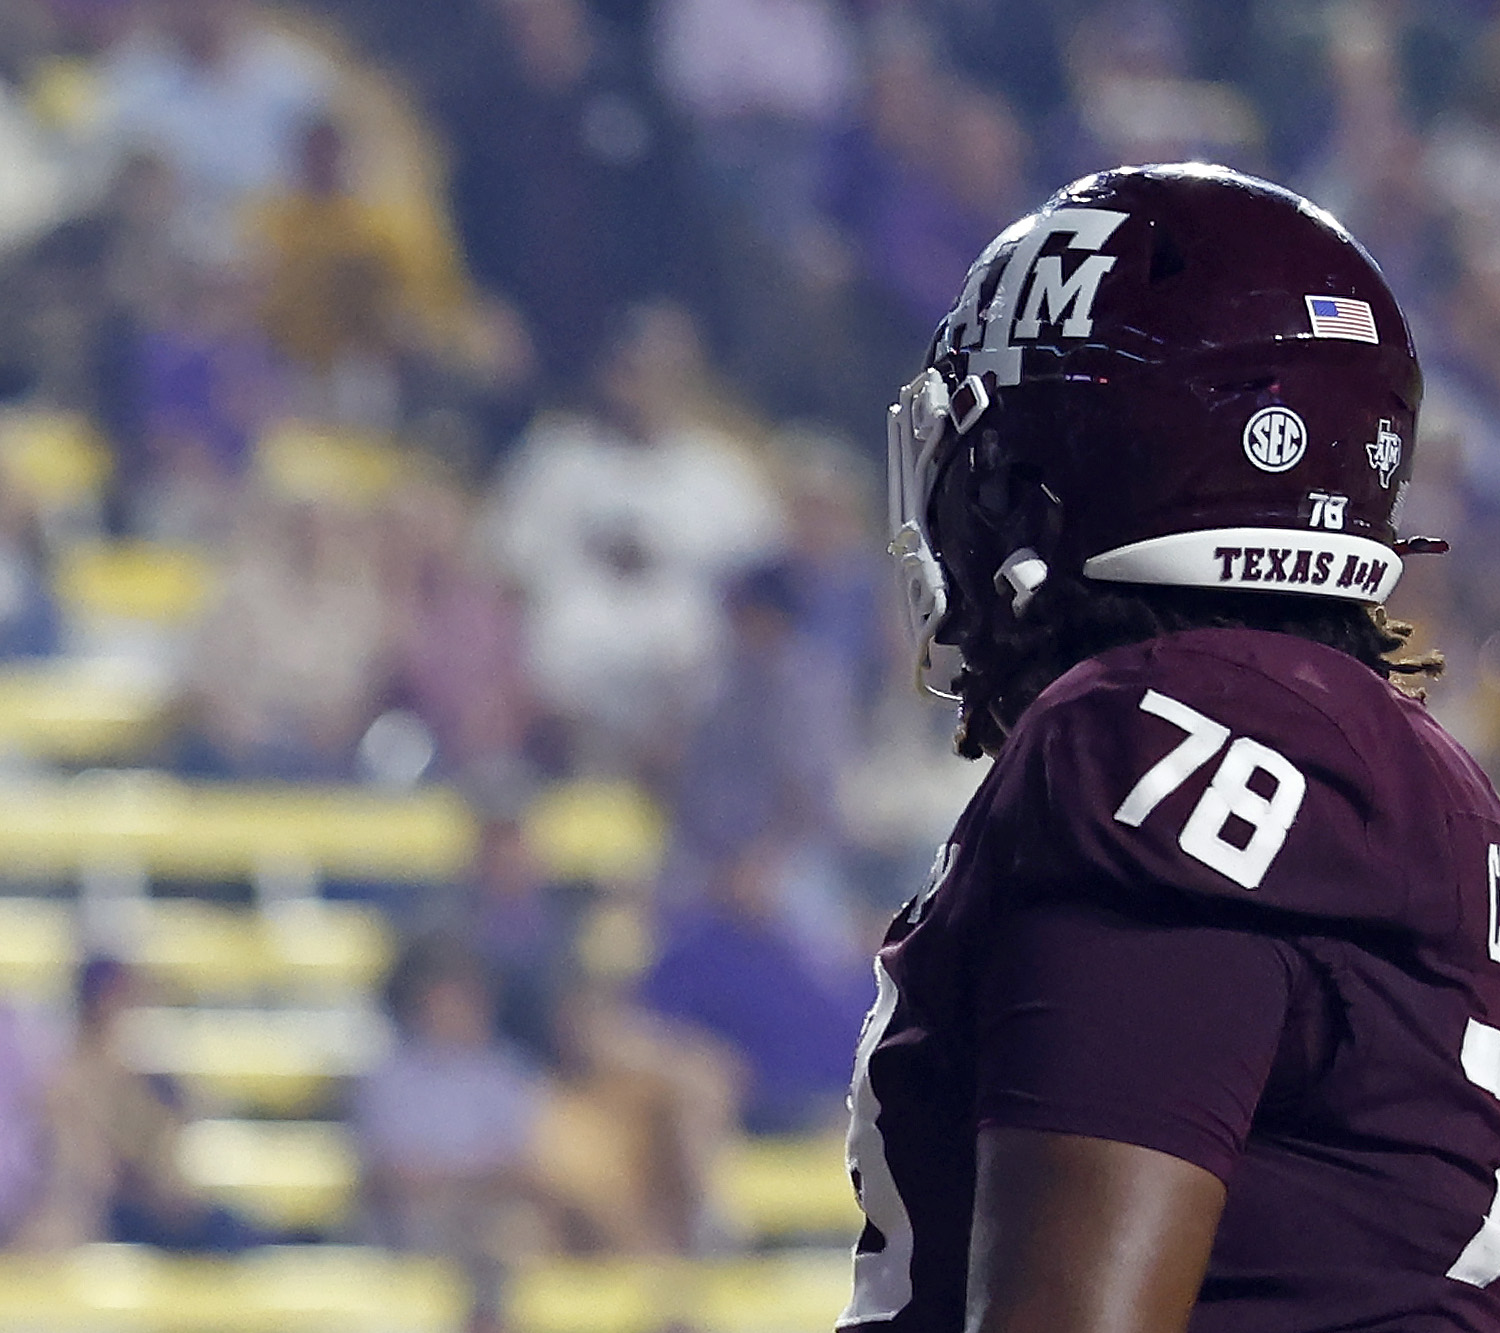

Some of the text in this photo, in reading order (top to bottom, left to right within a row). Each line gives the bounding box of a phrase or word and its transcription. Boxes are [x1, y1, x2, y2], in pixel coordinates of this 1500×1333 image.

[1251, 413, 1301, 463] SEC
[1308, 493, 1349, 529] 78
[1214, 546, 1389, 594] TEXAS A&M
[1113, 690, 1307, 890] 78
